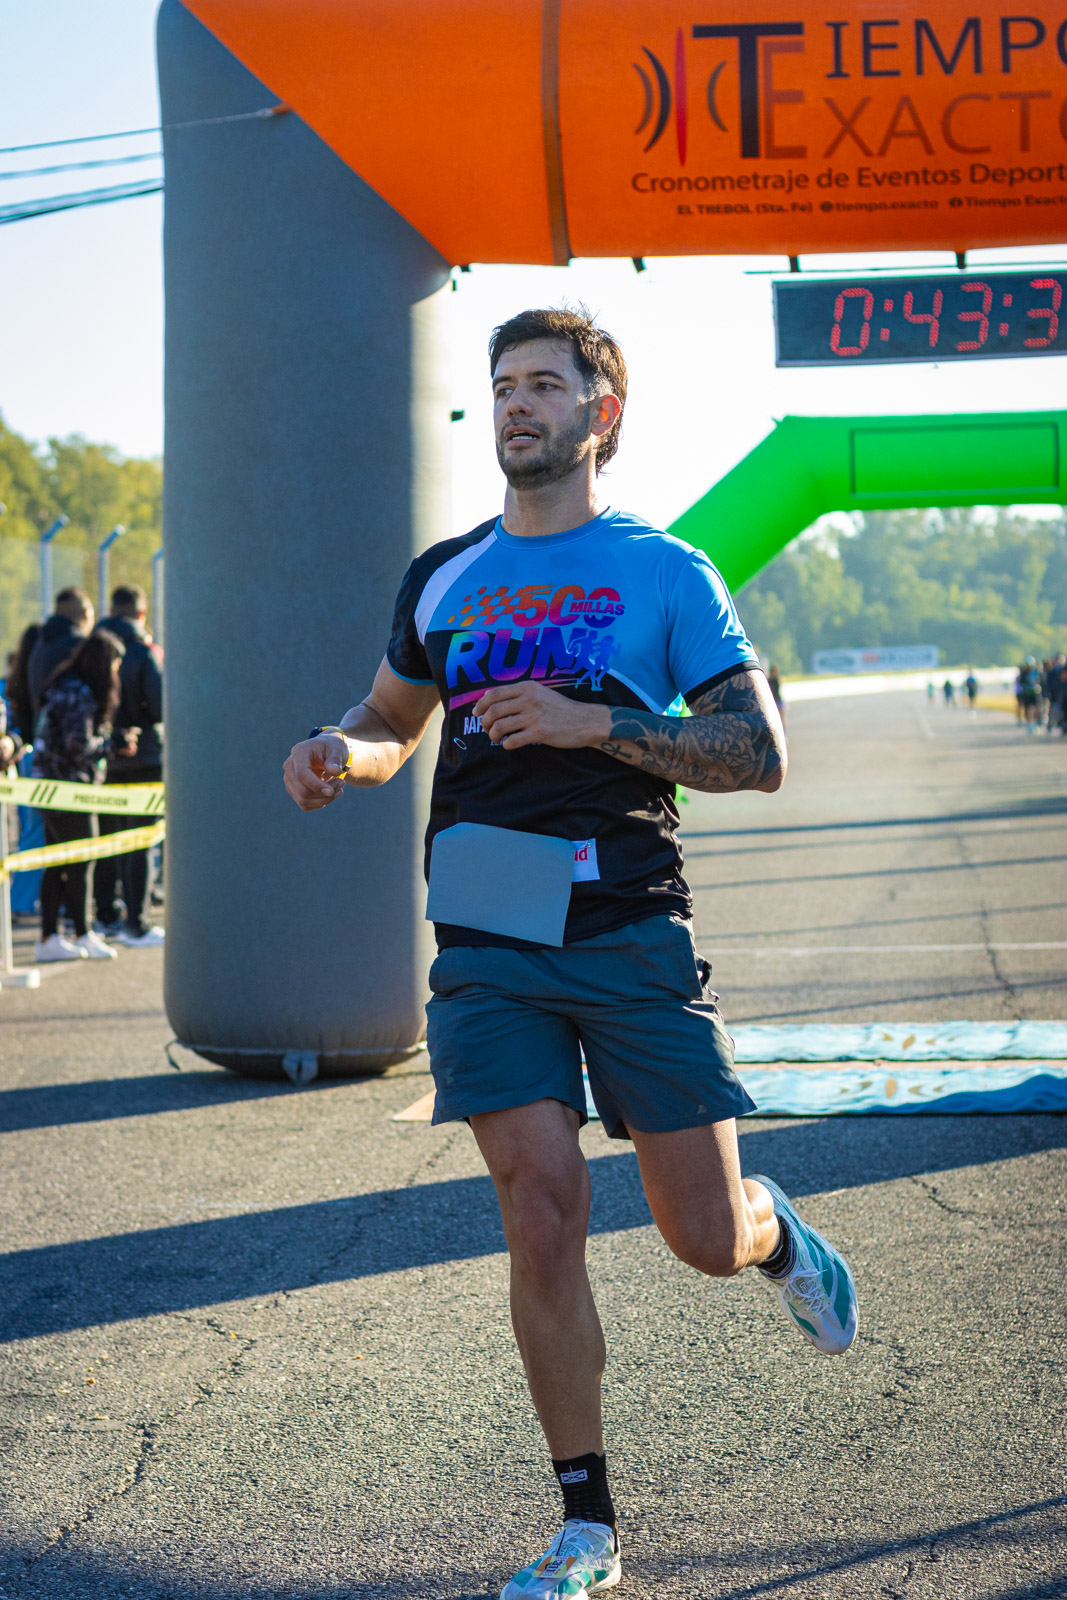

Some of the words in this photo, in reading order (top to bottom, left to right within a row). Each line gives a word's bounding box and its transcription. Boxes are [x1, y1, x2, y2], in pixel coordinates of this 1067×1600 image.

[631, 169, 809, 194] Cronometraje
[816, 167, 850, 189] de
[857, 166, 962, 188] Eventos
[677, 204, 693, 215] EL
[697, 203, 751, 215] TREBOL
[791, 201, 813, 214] Fe)
[835, 198, 939, 212] tiempo.exacto
[964, 195, 1022, 208] Tiempo
[512, 584, 621, 628] 500
[569, 601, 625, 615] MILLAS
[446, 626, 590, 689] RUN
[73, 792, 129, 806] PRECAUCION
